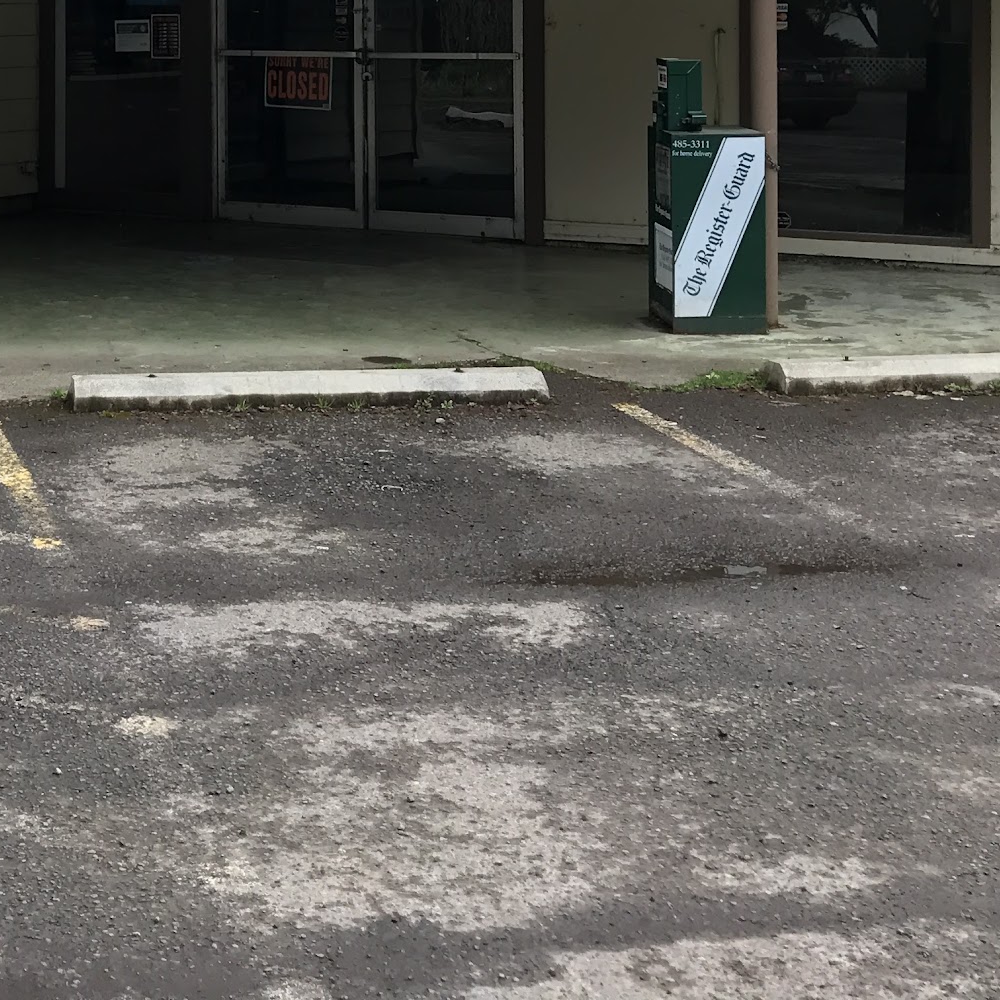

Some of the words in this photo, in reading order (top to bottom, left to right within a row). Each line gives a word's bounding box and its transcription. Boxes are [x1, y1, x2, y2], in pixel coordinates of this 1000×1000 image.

[267, 69, 329, 101] CLOSED
[672, 140, 711, 149] 485-3311
[694, 151, 757, 268] Register-Guard
[683, 266, 708, 297] The
